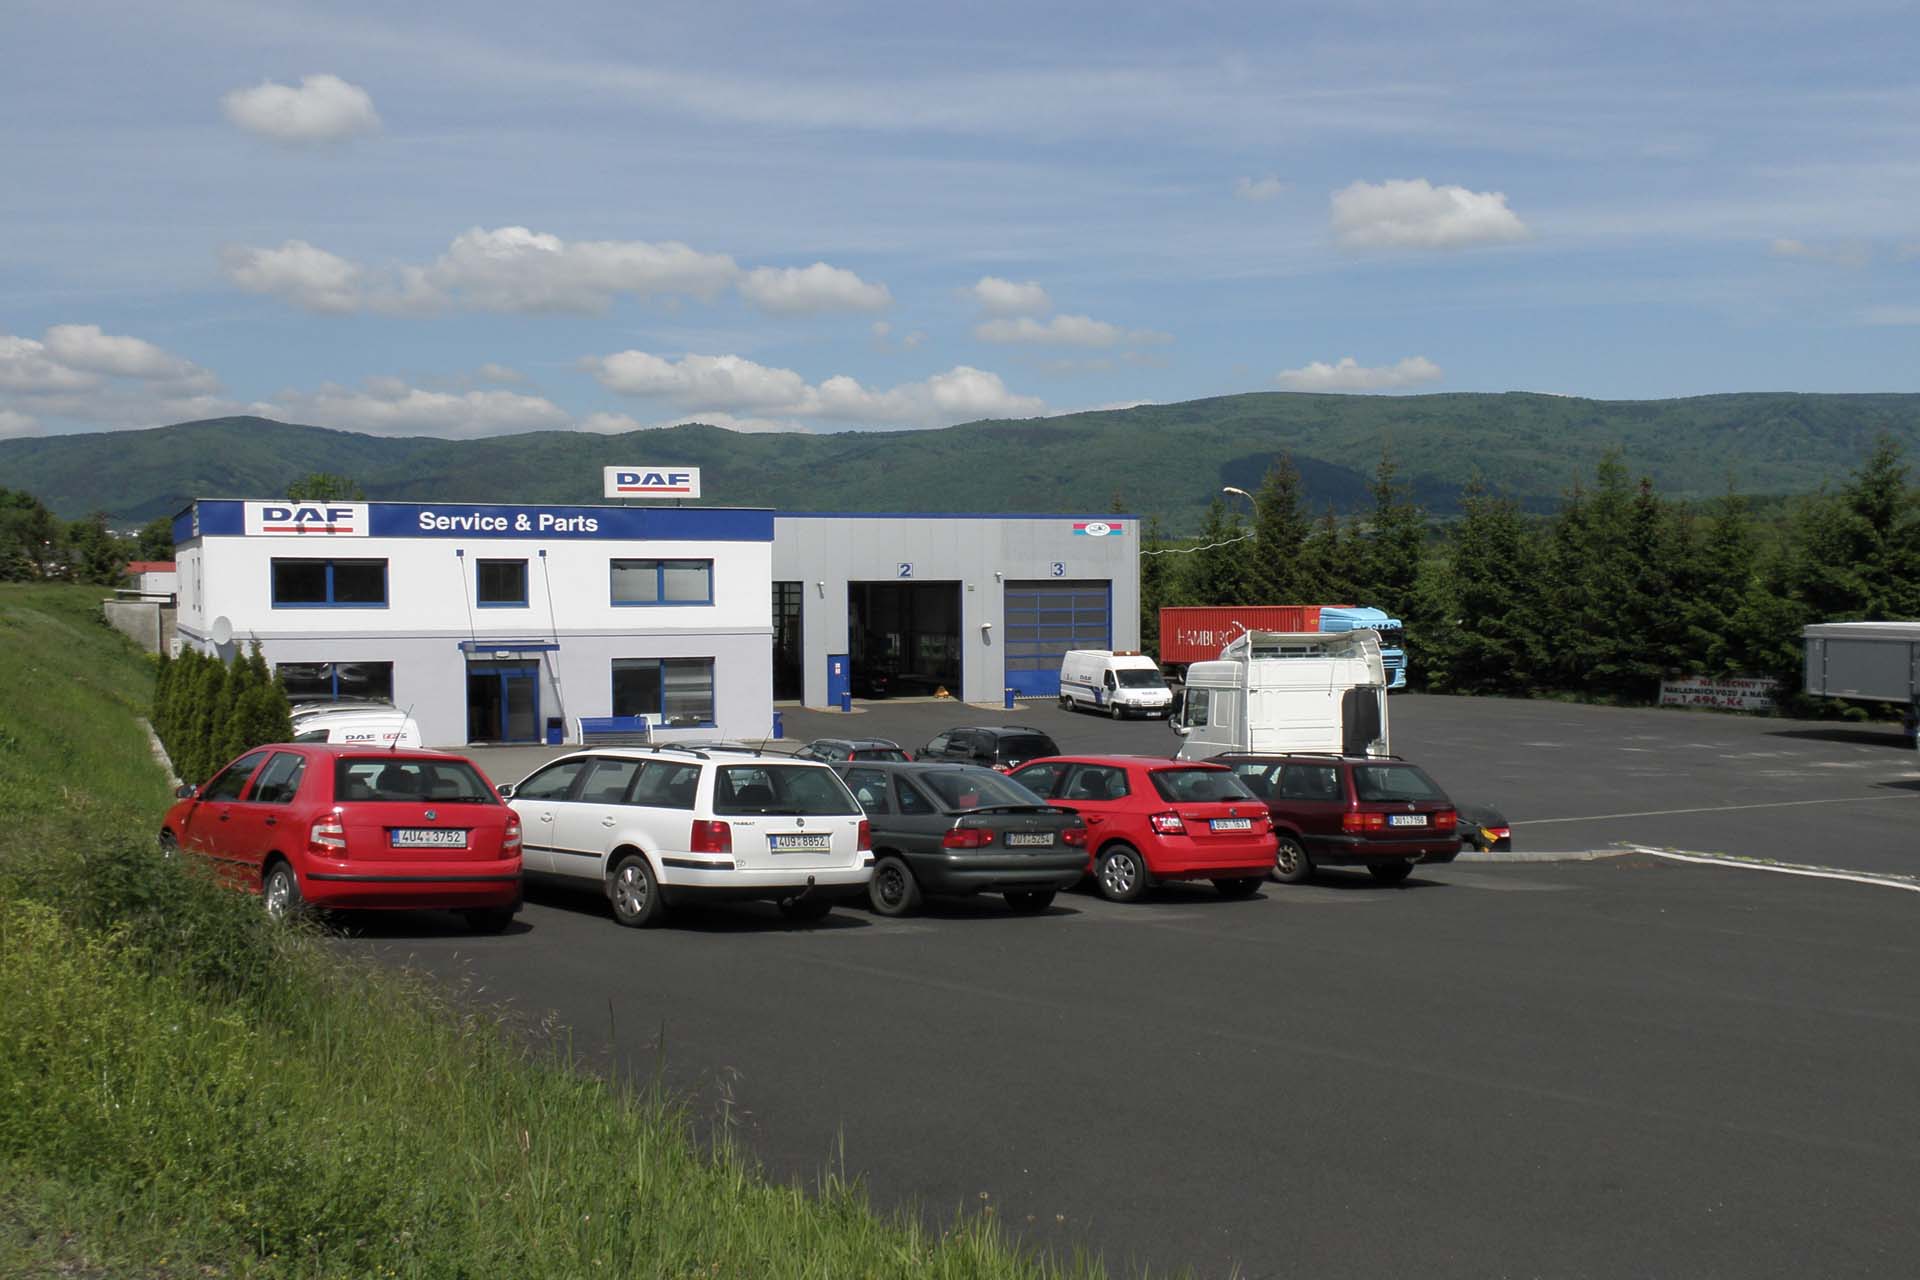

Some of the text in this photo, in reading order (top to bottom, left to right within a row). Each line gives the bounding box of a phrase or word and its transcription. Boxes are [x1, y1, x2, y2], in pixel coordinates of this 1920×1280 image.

[616, 472, 690, 486] DAF
[262, 507, 354, 523] DAF
[418, 511, 599, 532] Service & Parts
[899, 563, 912, 578] 2
[1053, 562, 1064, 577] 3
